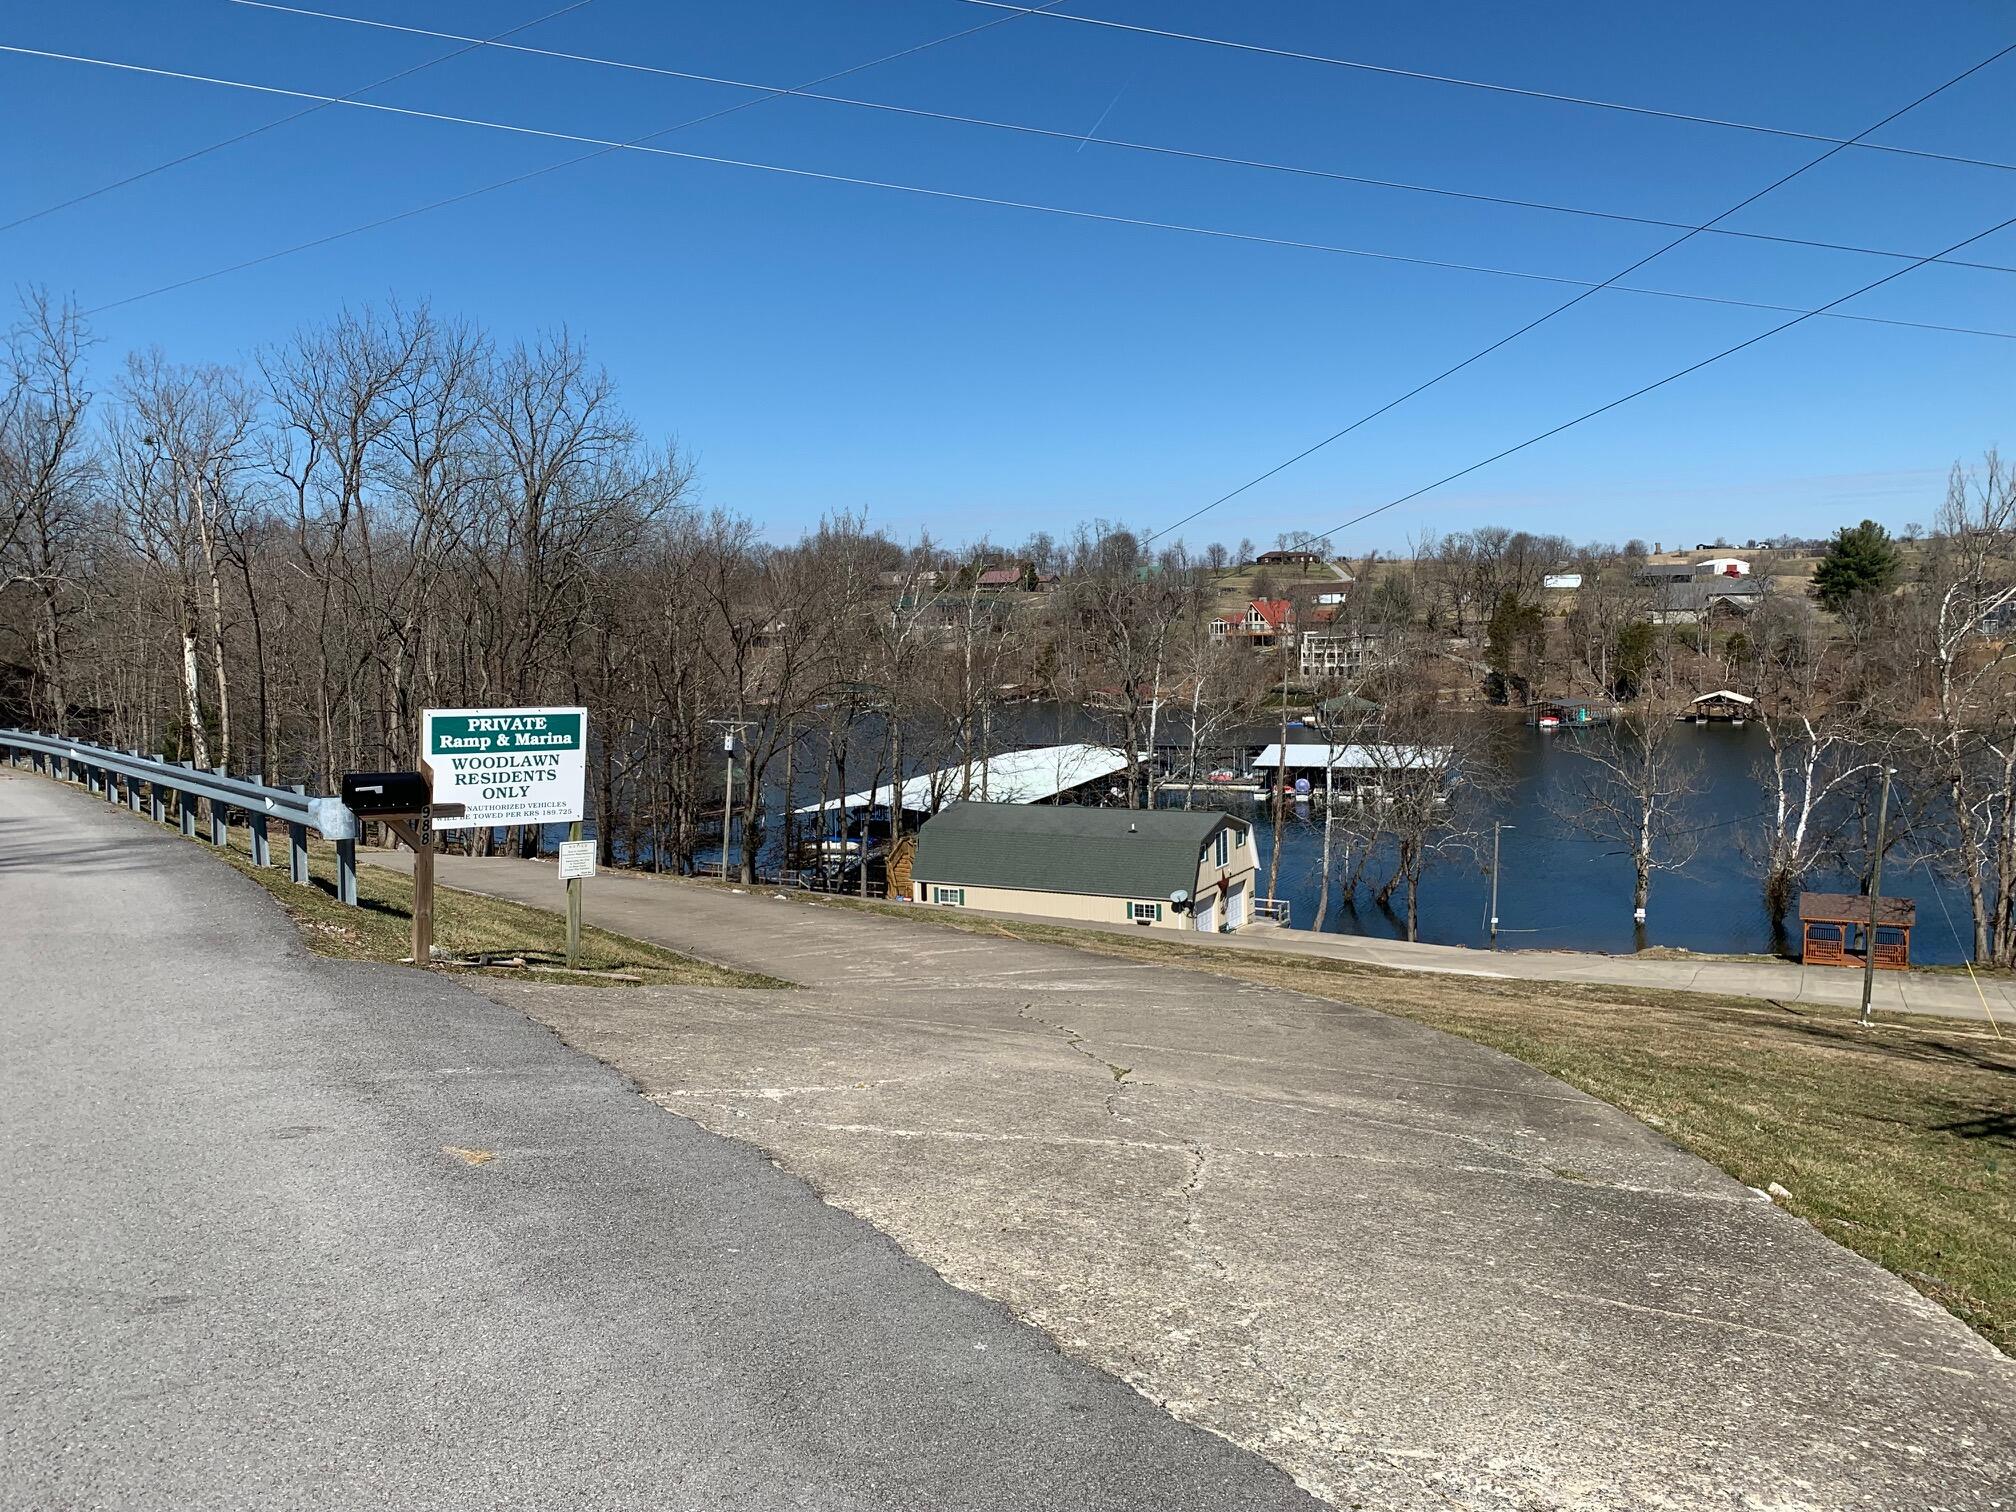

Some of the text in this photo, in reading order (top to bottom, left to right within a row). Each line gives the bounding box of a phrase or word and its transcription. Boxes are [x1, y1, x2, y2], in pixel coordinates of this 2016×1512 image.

[468, 717, 547, 731] PRIVATE
[440, 732, 572, 750] Ramp & Marina
[452, 754, 560, 770] WOODLAWN
[455, 769, 557, 785] RESIDENTS
[482, 786, 530, 799] ONLY
[465, 801, 567, 812] NAUTHORIZED VEHICLES
[542, 808, 573, 816] 189.725
[421, 806, 431, 845] 988
